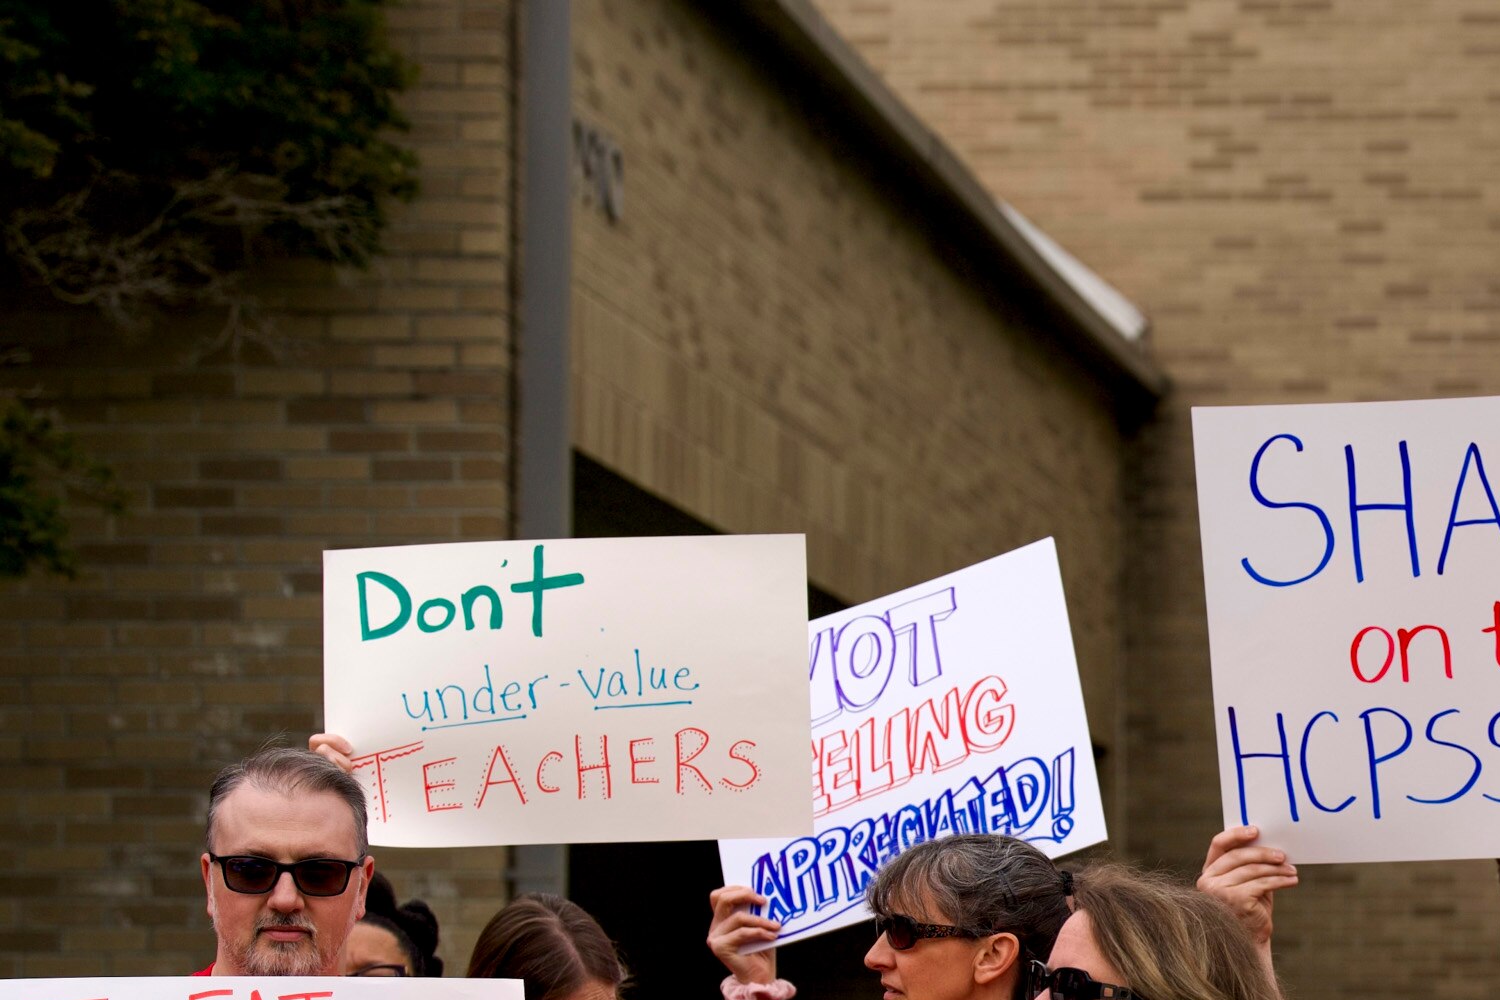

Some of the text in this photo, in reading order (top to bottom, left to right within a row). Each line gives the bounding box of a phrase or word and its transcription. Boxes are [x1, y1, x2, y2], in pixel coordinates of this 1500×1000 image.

[356, 544, 585, 642] Don't
[401, 647, 702, 722] under-value
[1350, 625, 1453, 683] on
[351, 727, 761, 825] TEACHERS
[811, 675, 1015, 819] ELING
[752, 746, 1075, 926] APPRECIATED!
